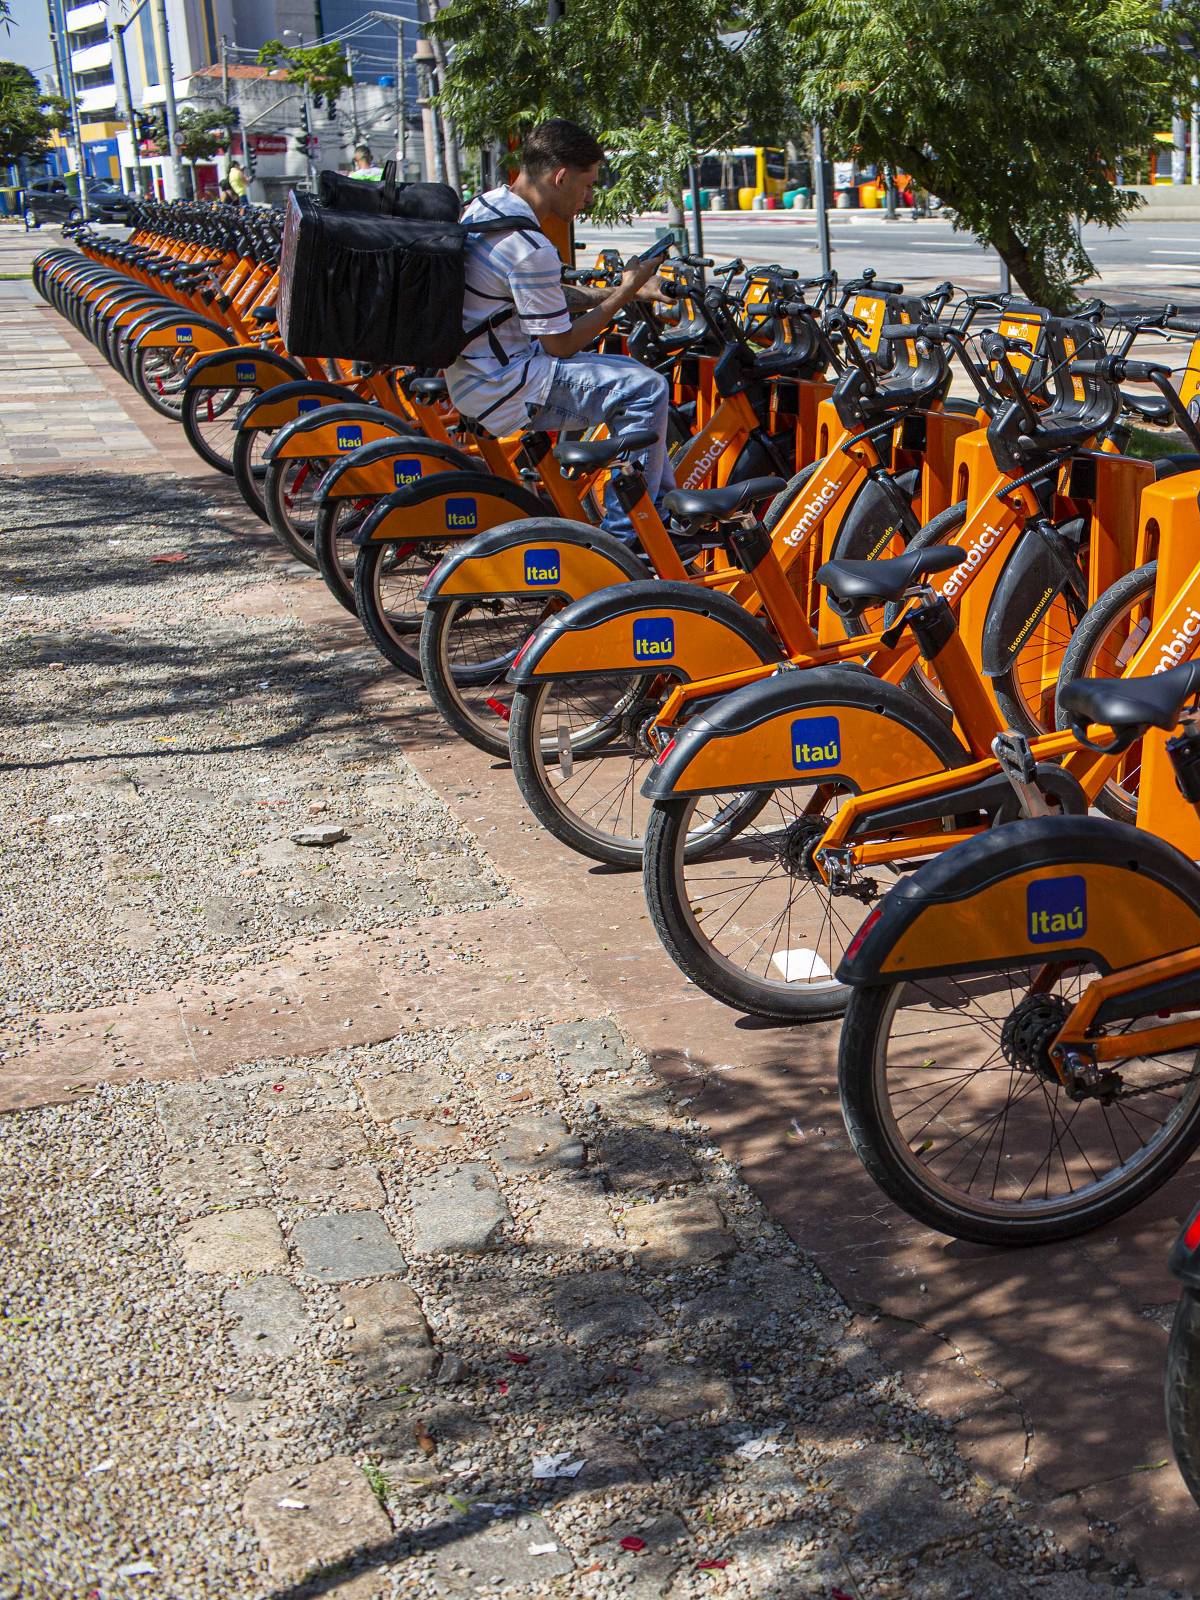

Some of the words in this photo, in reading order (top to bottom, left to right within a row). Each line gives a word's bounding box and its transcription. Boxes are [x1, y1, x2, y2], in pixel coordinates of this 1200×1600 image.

[338, 436, 362, 449] Itaú
[683, 437, 728, 490] embici.
[448, 513, 476, 526] Itaú
[527, 566, 559, 581] Itaú
[636, 637, 673, 655] Itaú
[795, 741, 838, 764] Itaú
[1031, 906, 1084, 935] Itaú
